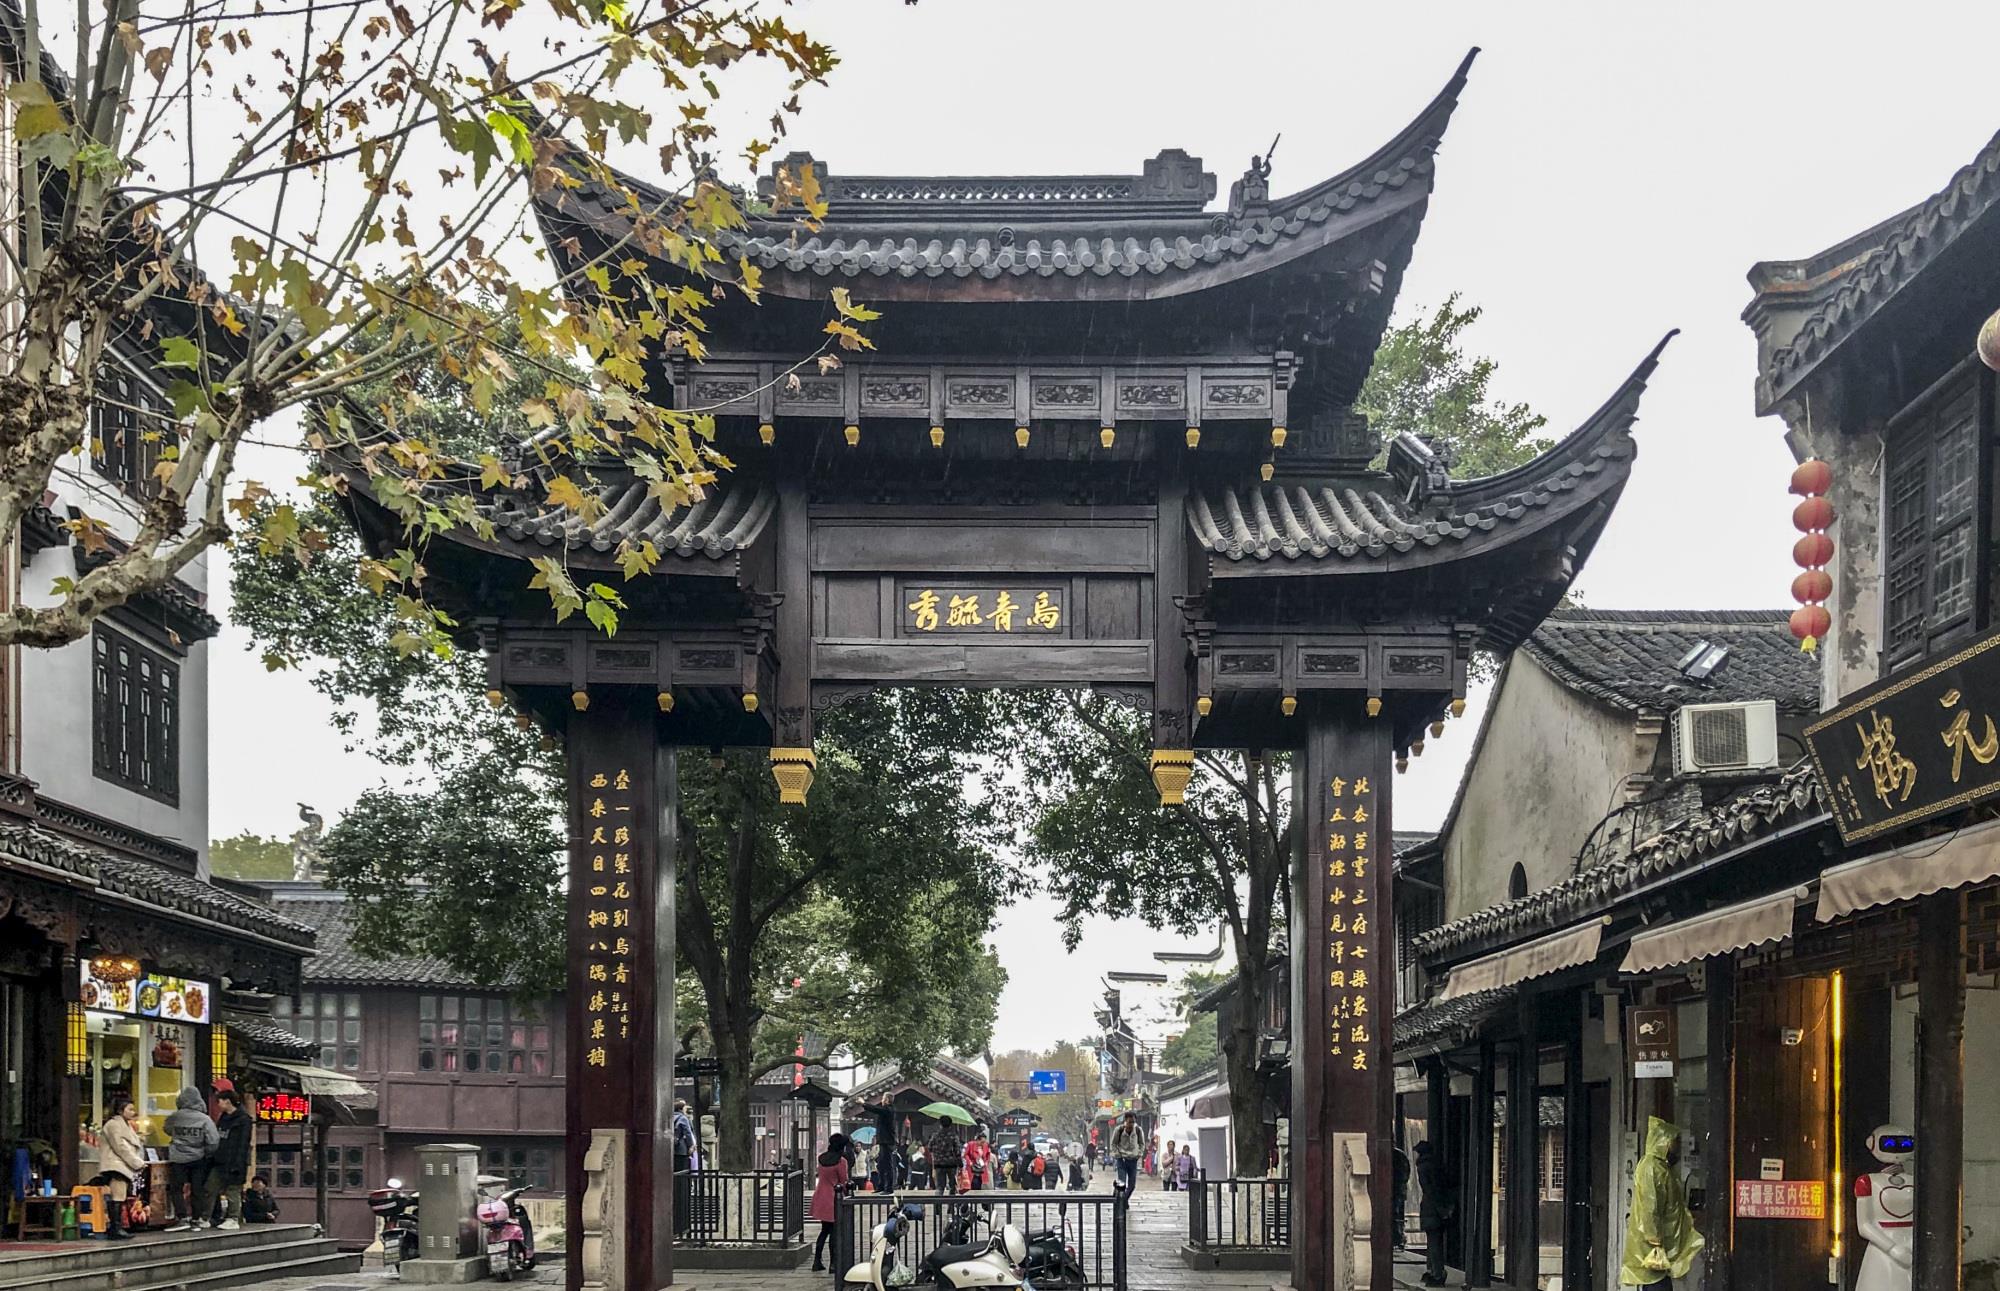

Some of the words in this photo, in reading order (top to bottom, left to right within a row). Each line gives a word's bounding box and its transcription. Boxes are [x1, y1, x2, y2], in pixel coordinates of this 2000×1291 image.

[1638, 1050, 1670, 1060] 售票处
[261, 1094, 305, 1111] 水果店
